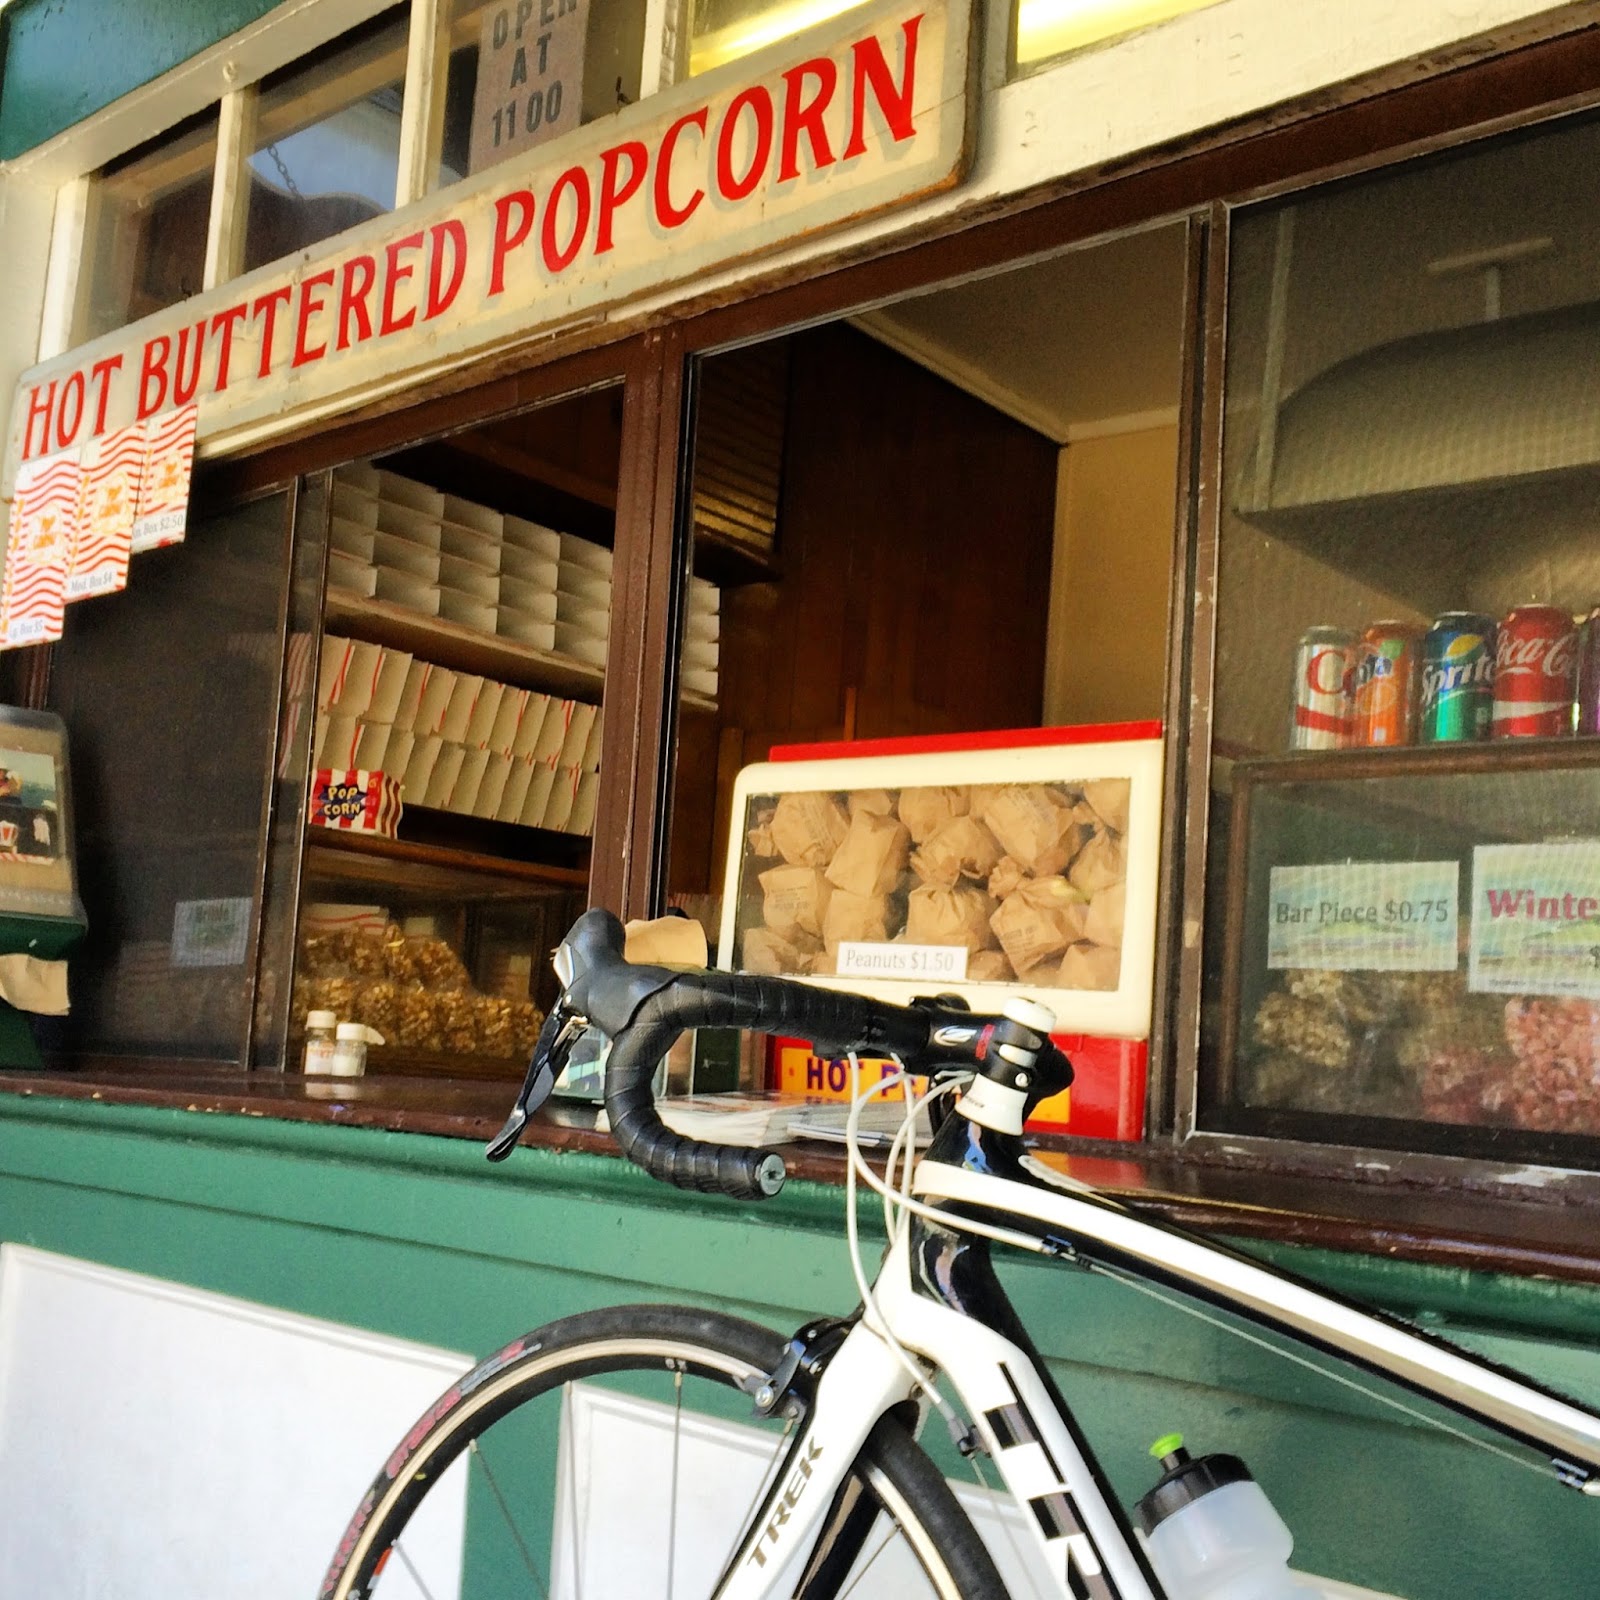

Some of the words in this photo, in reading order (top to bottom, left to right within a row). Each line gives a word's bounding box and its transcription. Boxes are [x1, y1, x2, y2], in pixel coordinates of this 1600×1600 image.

[510, 31, 552, 89] AT
[22, 355, 122, 460] HOT
[136, 219, 467, 421] BUTTERED
[487, 13, 926, 297] POPCORN
[327, 786, 359, 800] POP
[323, 802, 361, 816] CORN
[1275, 902, 1313, 924] Bar
[1318, 900, 1378, 924] Piece
[1384, 899, 1449, 924] $0.75
[1486, 888, 1599, 921] Winte
[845, 948, 907, 970] Peanuts
[910, 951, 955, 973] $1.50
[746, 1436, 824, 1568] TREK
